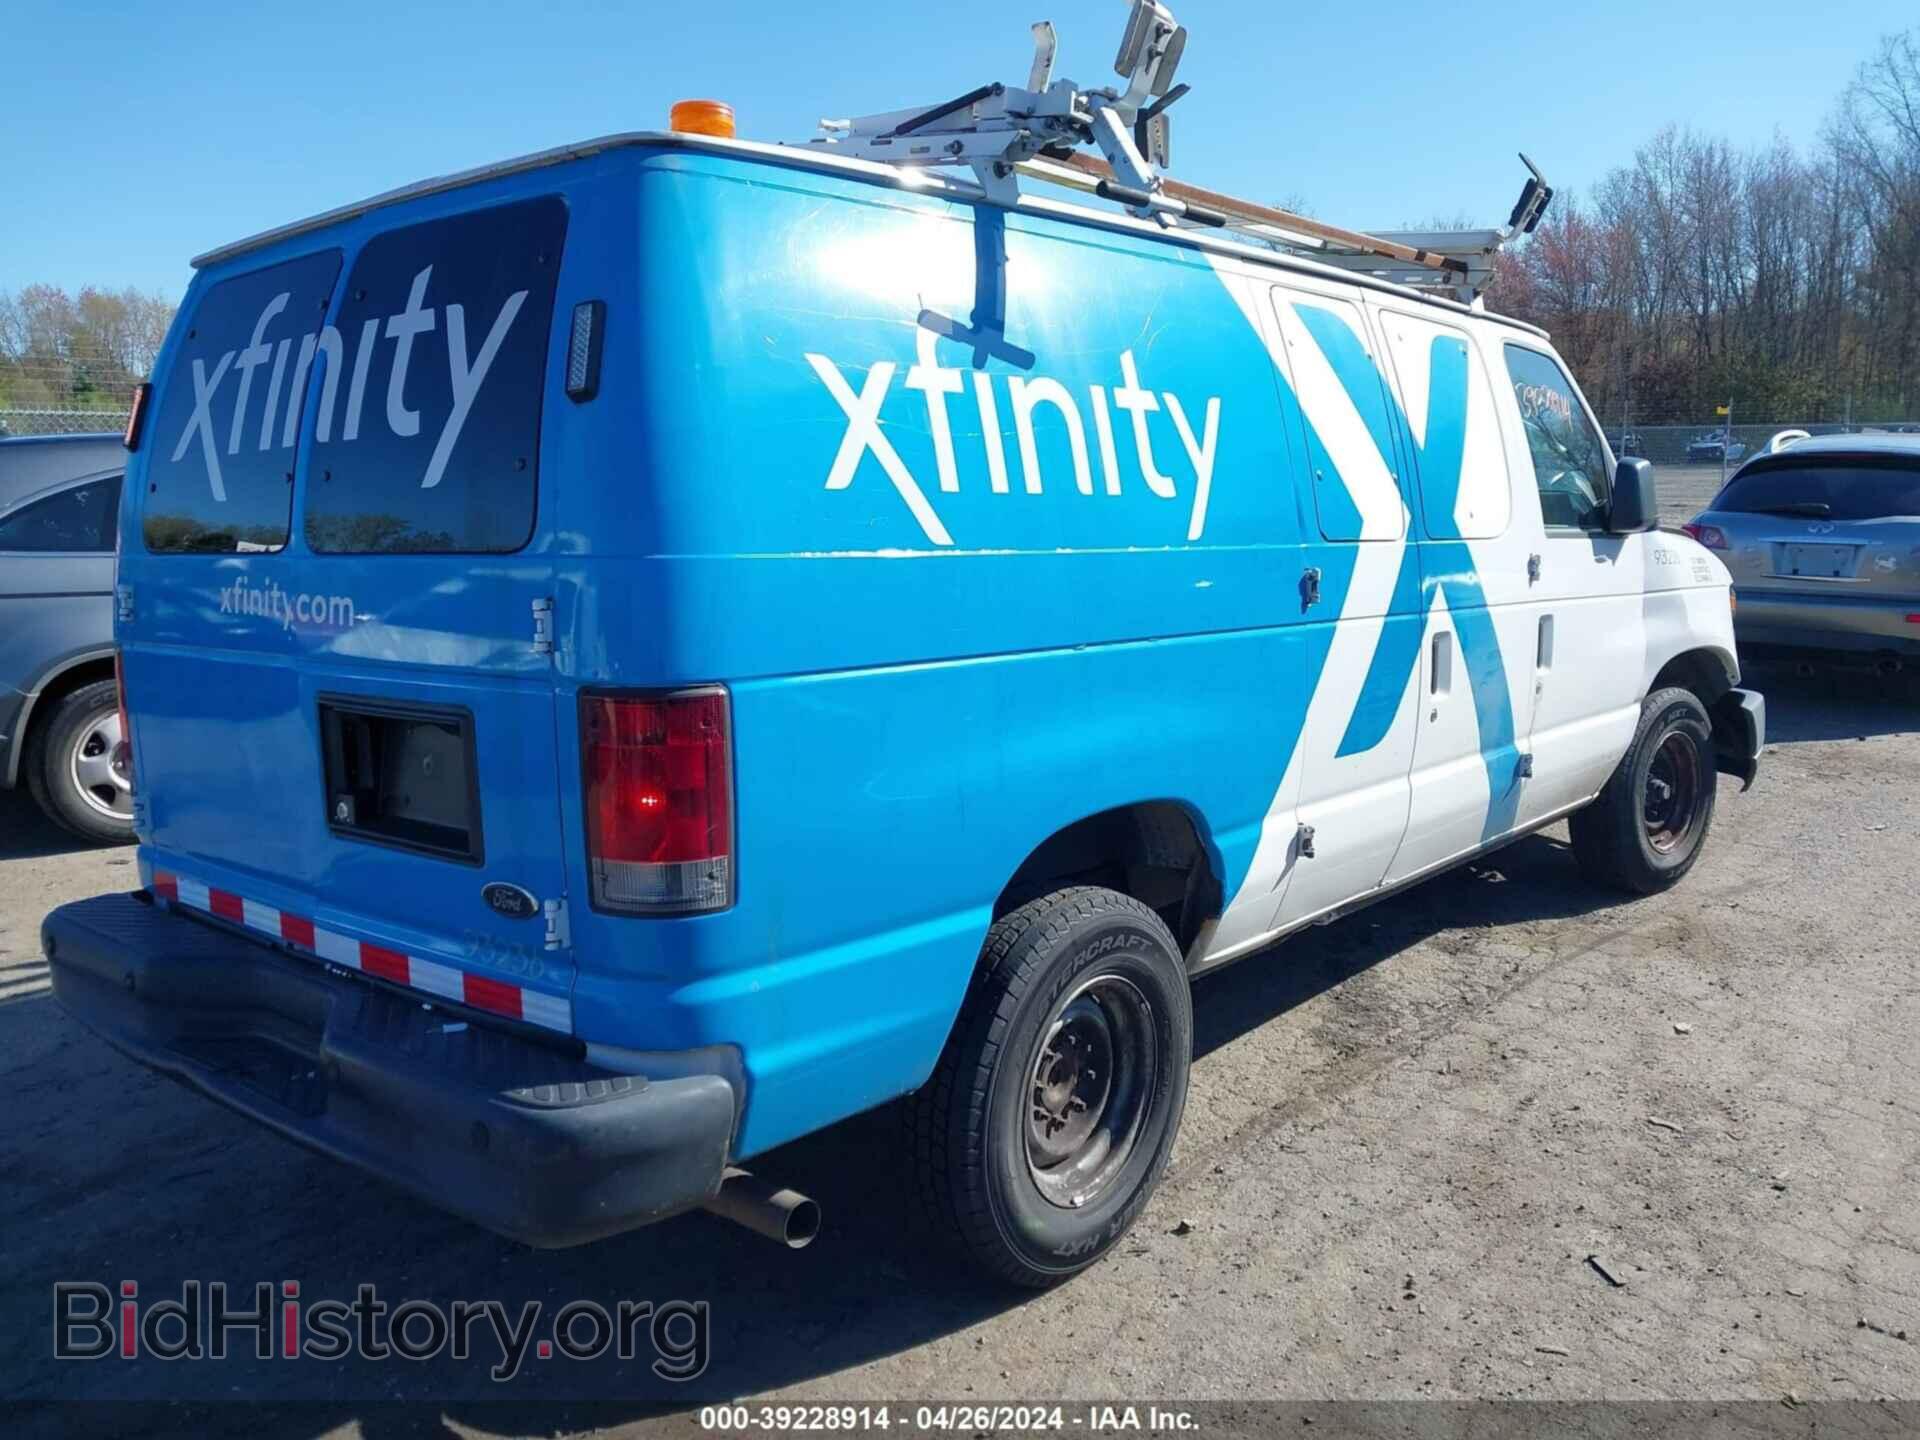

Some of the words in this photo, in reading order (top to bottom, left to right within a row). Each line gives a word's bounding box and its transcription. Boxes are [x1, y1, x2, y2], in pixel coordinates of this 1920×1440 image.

[170, 264, 529, 501] xfinity
[803, 326, 1221, 546] xfinity
[219, 575, 355, 631] xfinity.com
[492, 888, 523, 913] Ford
